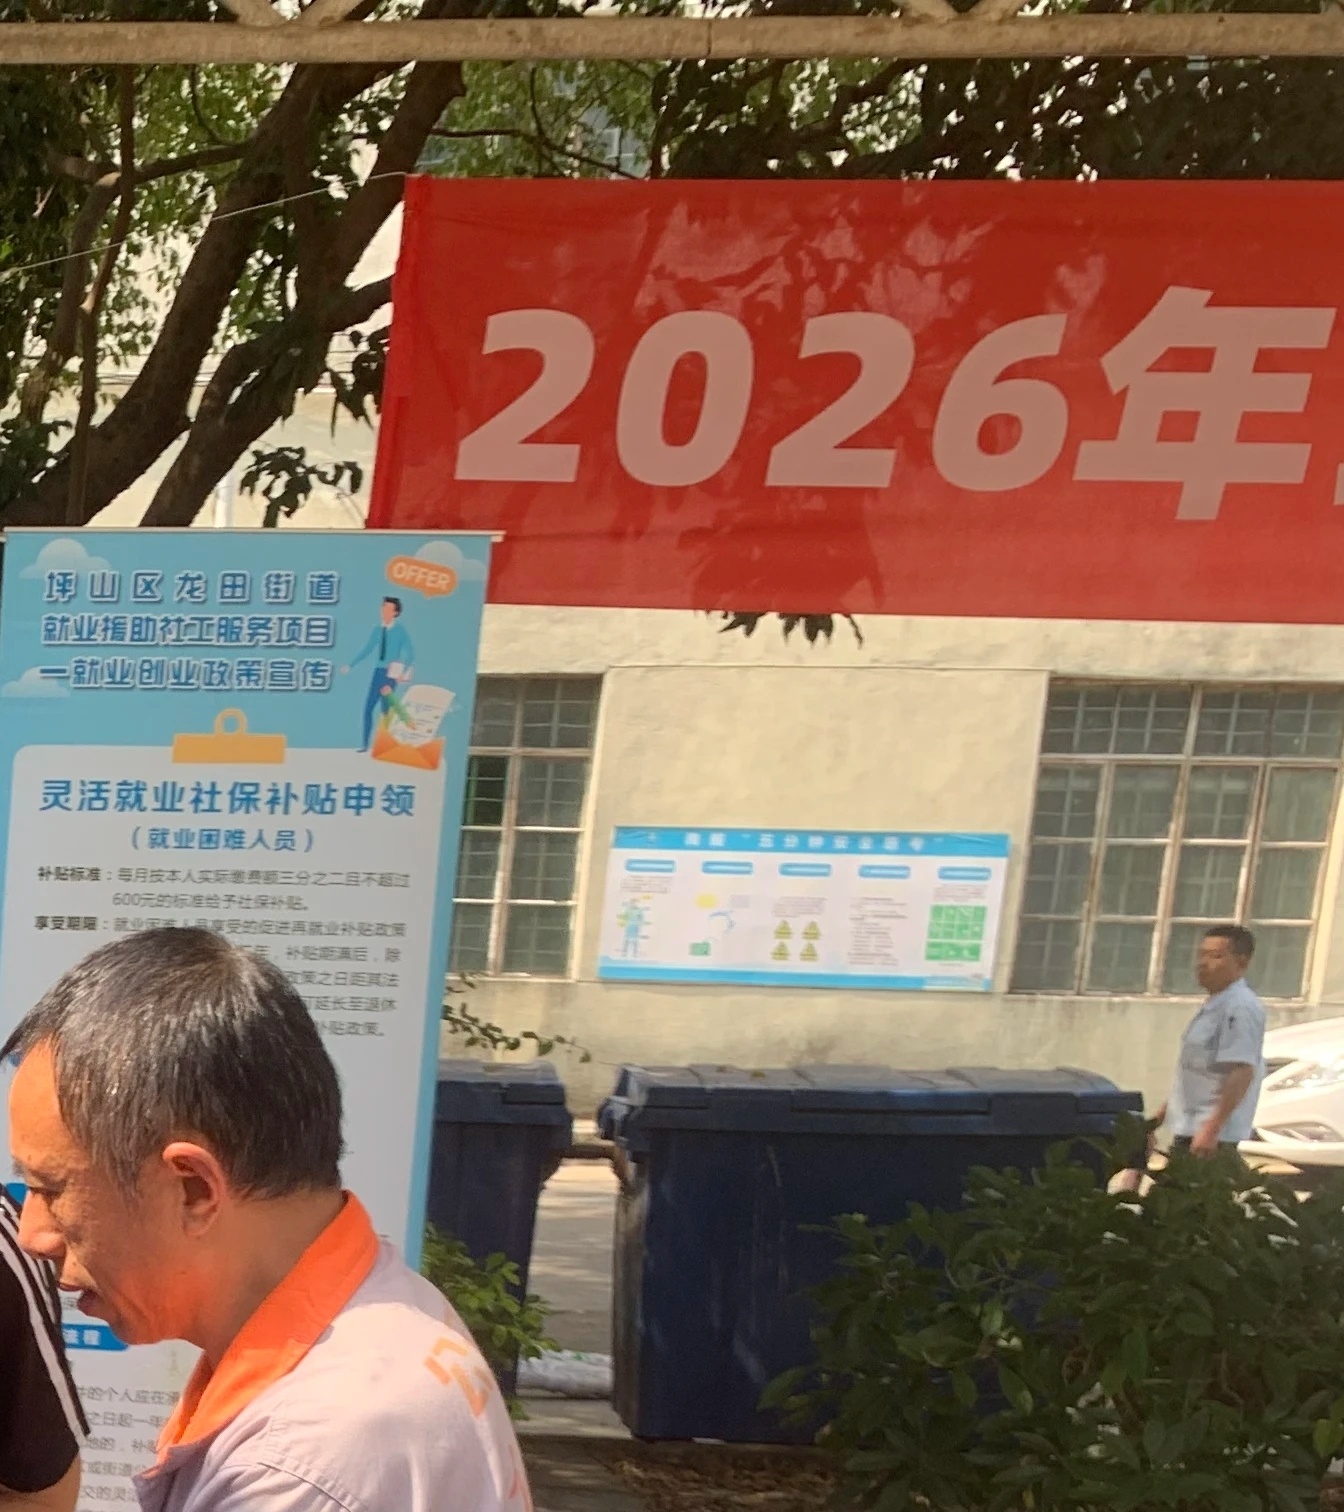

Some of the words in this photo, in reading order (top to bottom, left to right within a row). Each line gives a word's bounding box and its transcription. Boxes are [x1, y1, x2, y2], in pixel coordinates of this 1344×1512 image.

[454, 286, 1344, 522] 2026年
[44, 569, 340, 603] 坪山区龙田街道
[393, 563, 450, 592] OFFER
[41, 613, 335, 648] 就业援助社工服务项目
[39, 778, 417, 817] 灵活就业社保补贴申领
[131, 826, 315, 853] （就业困难人员）
